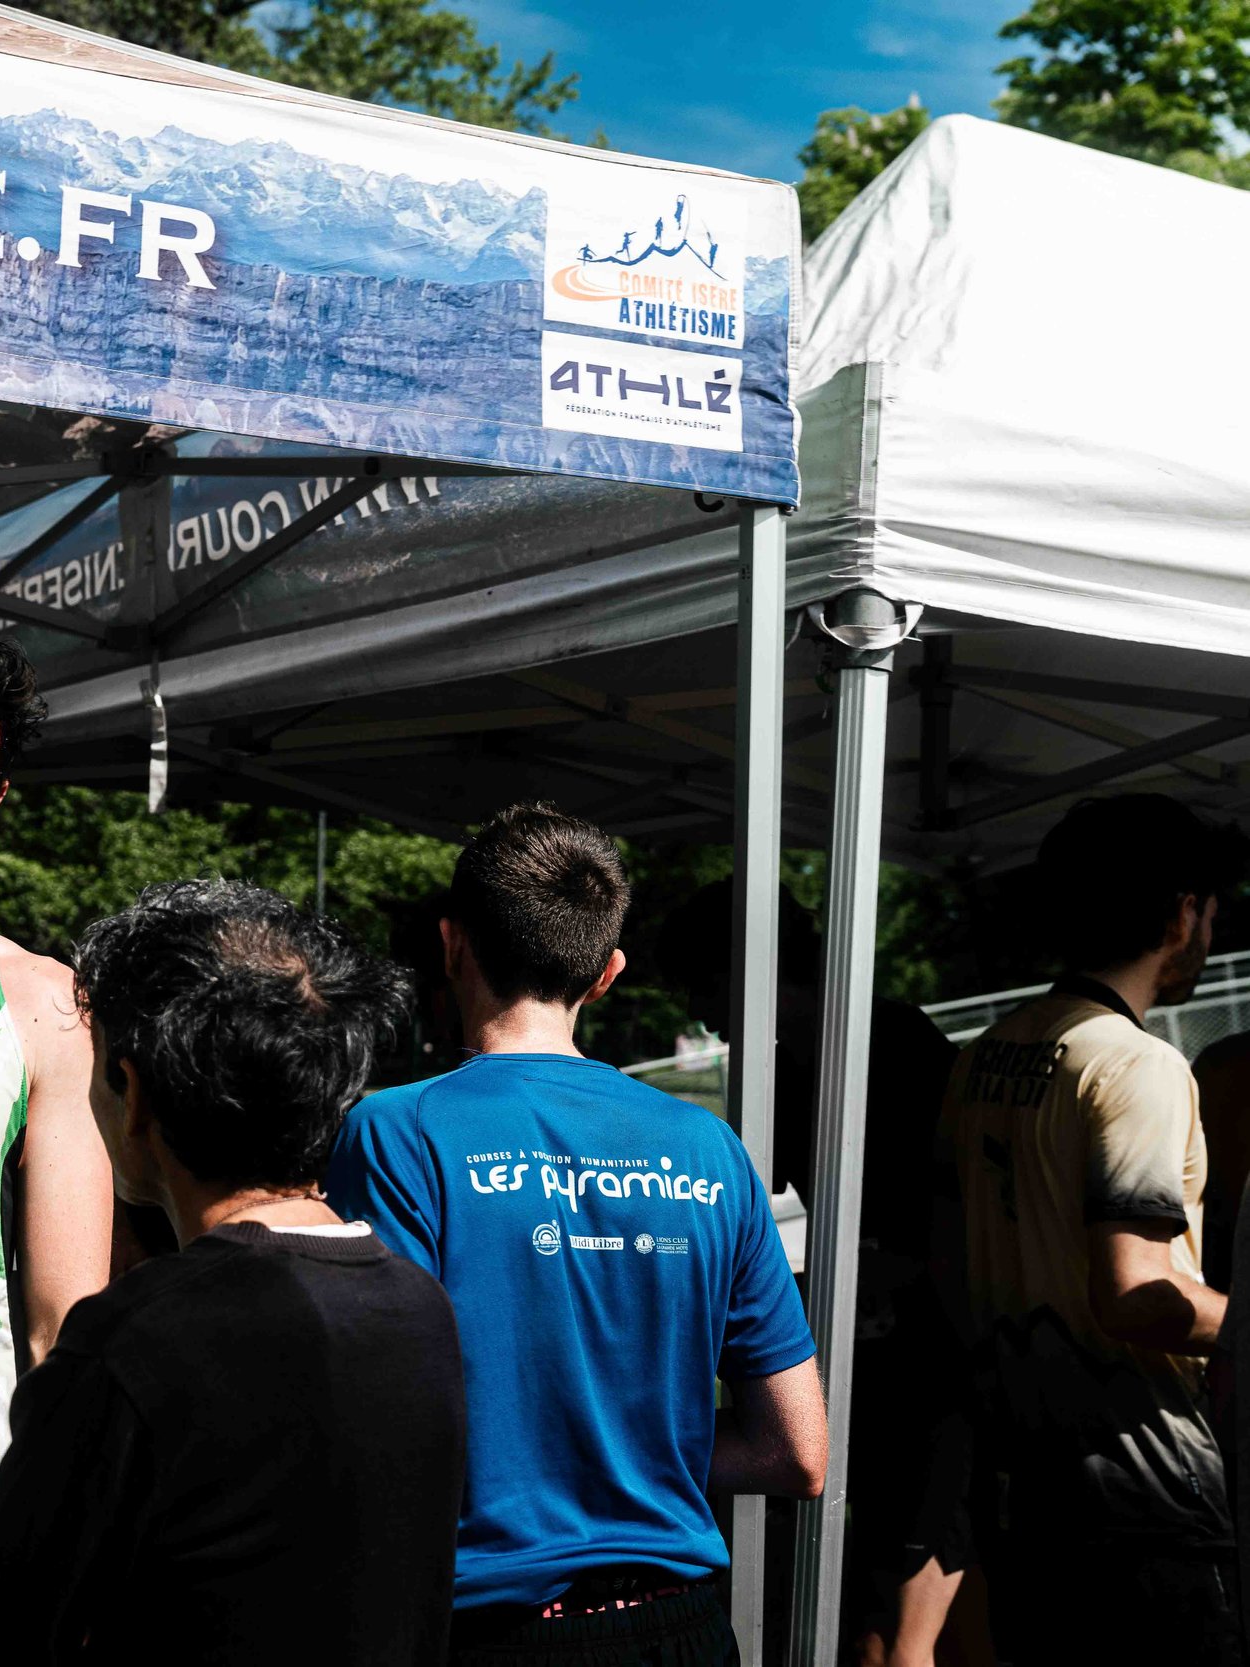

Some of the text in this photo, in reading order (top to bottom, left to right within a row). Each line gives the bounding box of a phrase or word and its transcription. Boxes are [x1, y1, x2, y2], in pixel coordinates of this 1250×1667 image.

[619, 297, 736, 340] ATHLÉTISME
[550, 361, 731, 414] ATHLÉ
[466, 1151, 512, 1164] COURSES
[580, 1156, 649, 1168] HUMANITAIRE
[469, 1163, 529, 1194] LES
[592, 1238, 622, 1248] Libre
